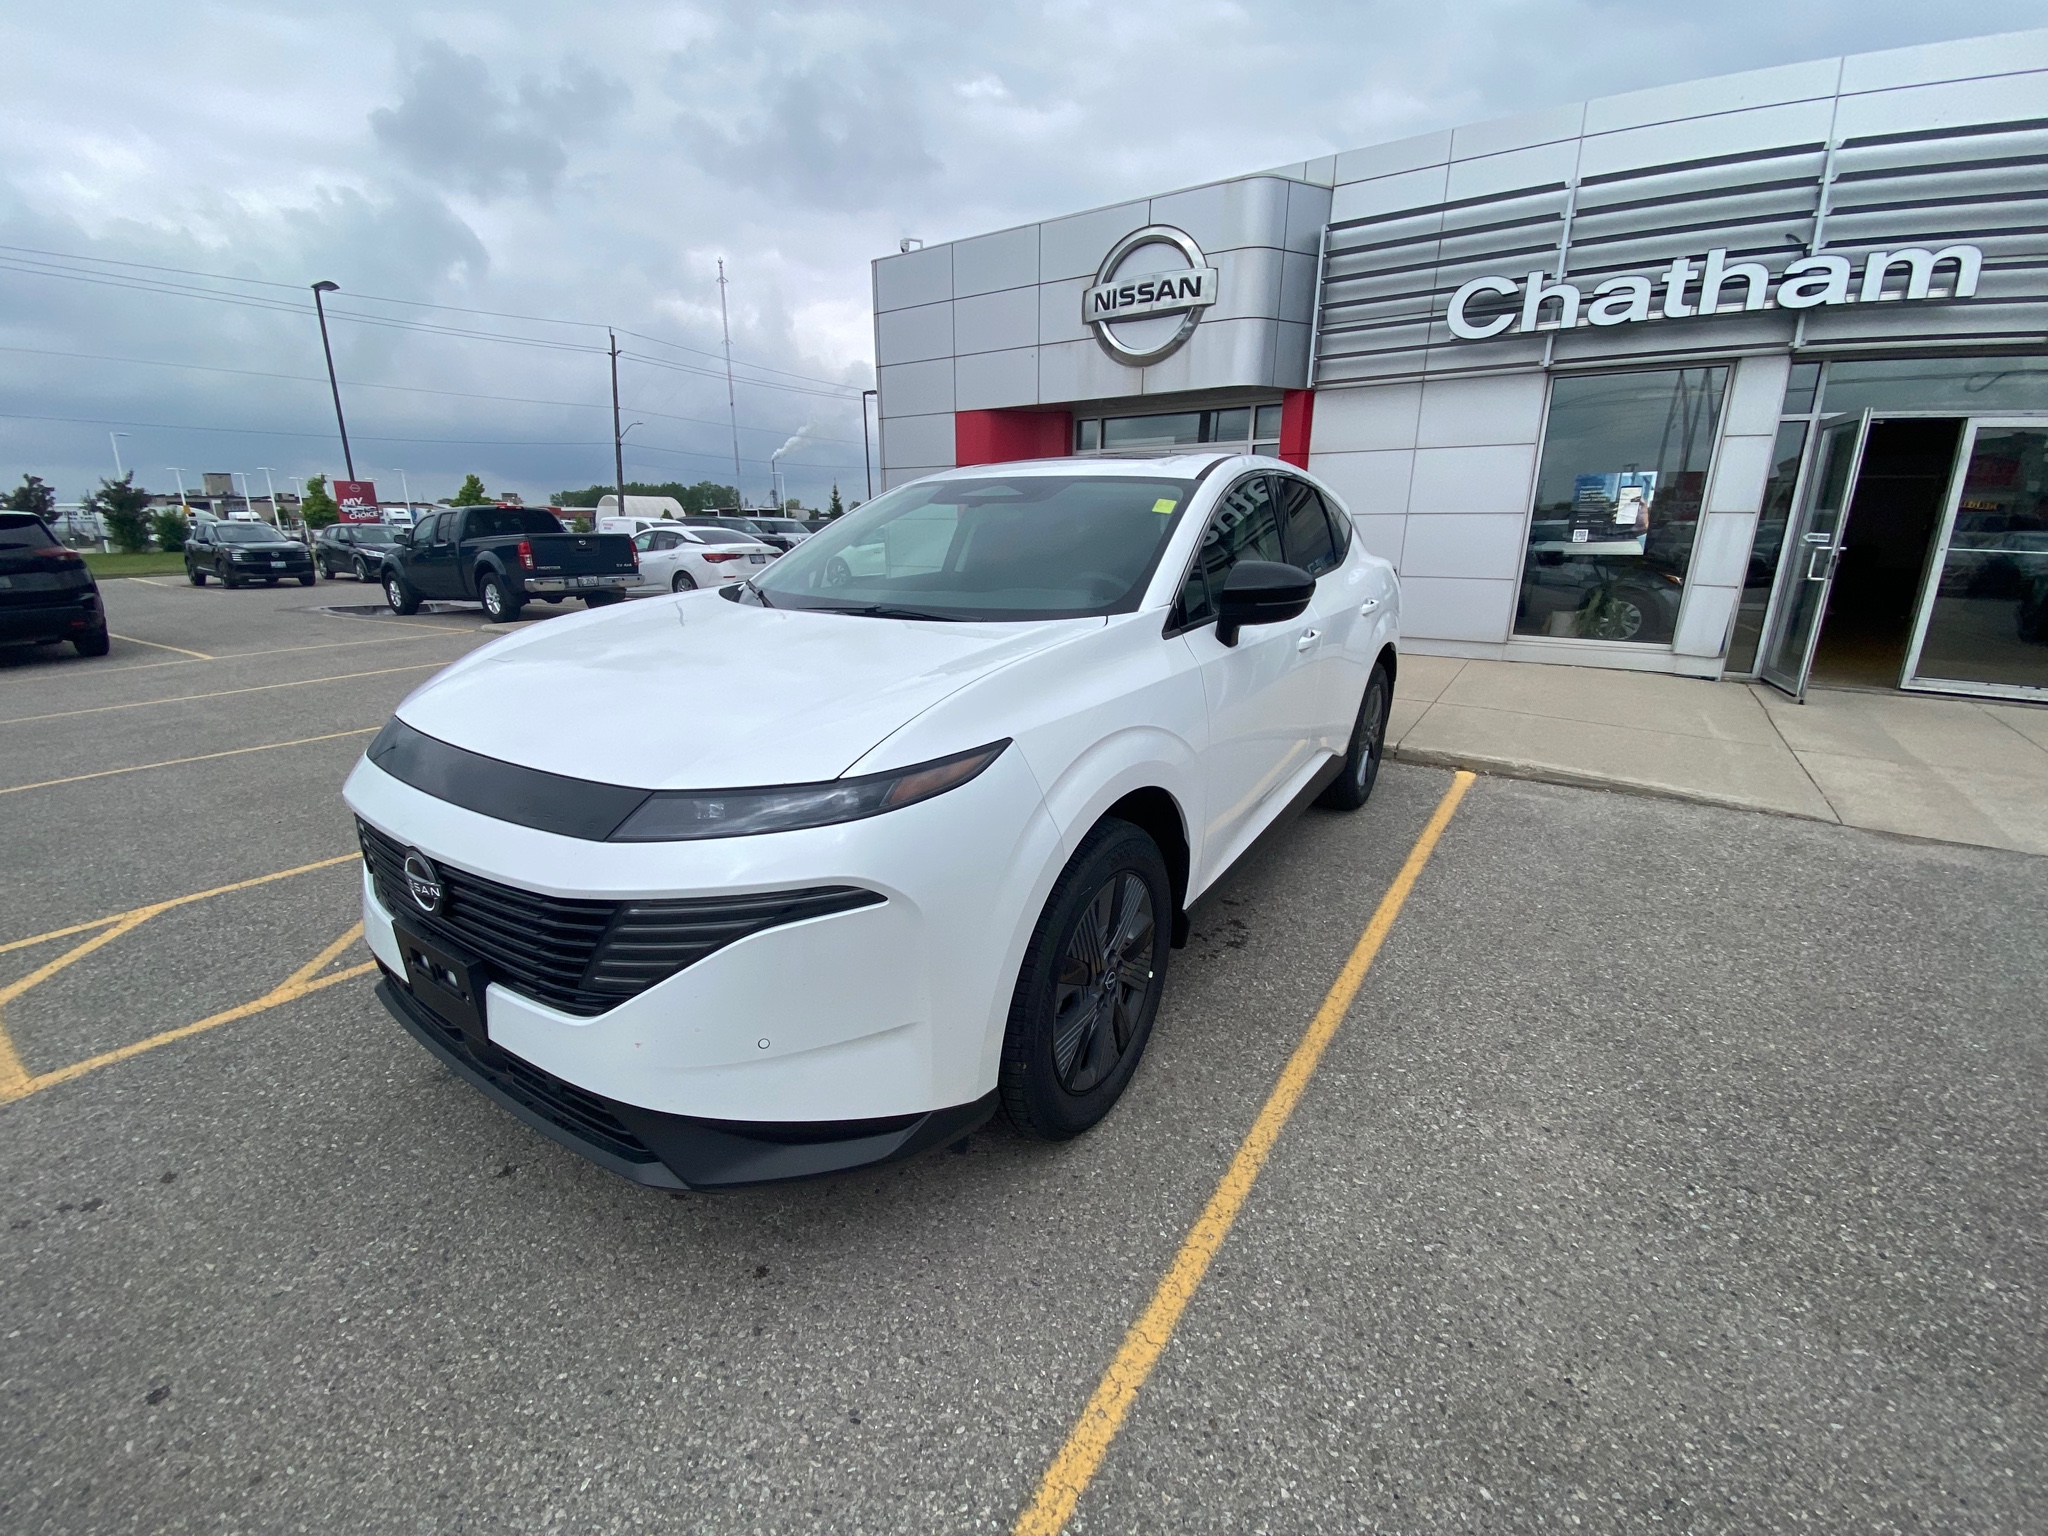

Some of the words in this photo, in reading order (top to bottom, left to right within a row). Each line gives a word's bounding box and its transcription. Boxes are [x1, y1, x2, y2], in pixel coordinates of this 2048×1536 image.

[1094, 275, 1203, 313] NISSAN
[1446, 243, 1985, 341] Chatham
[343, 497, 363, 506] MY
[349, 511, 379, 520] CHOICE
